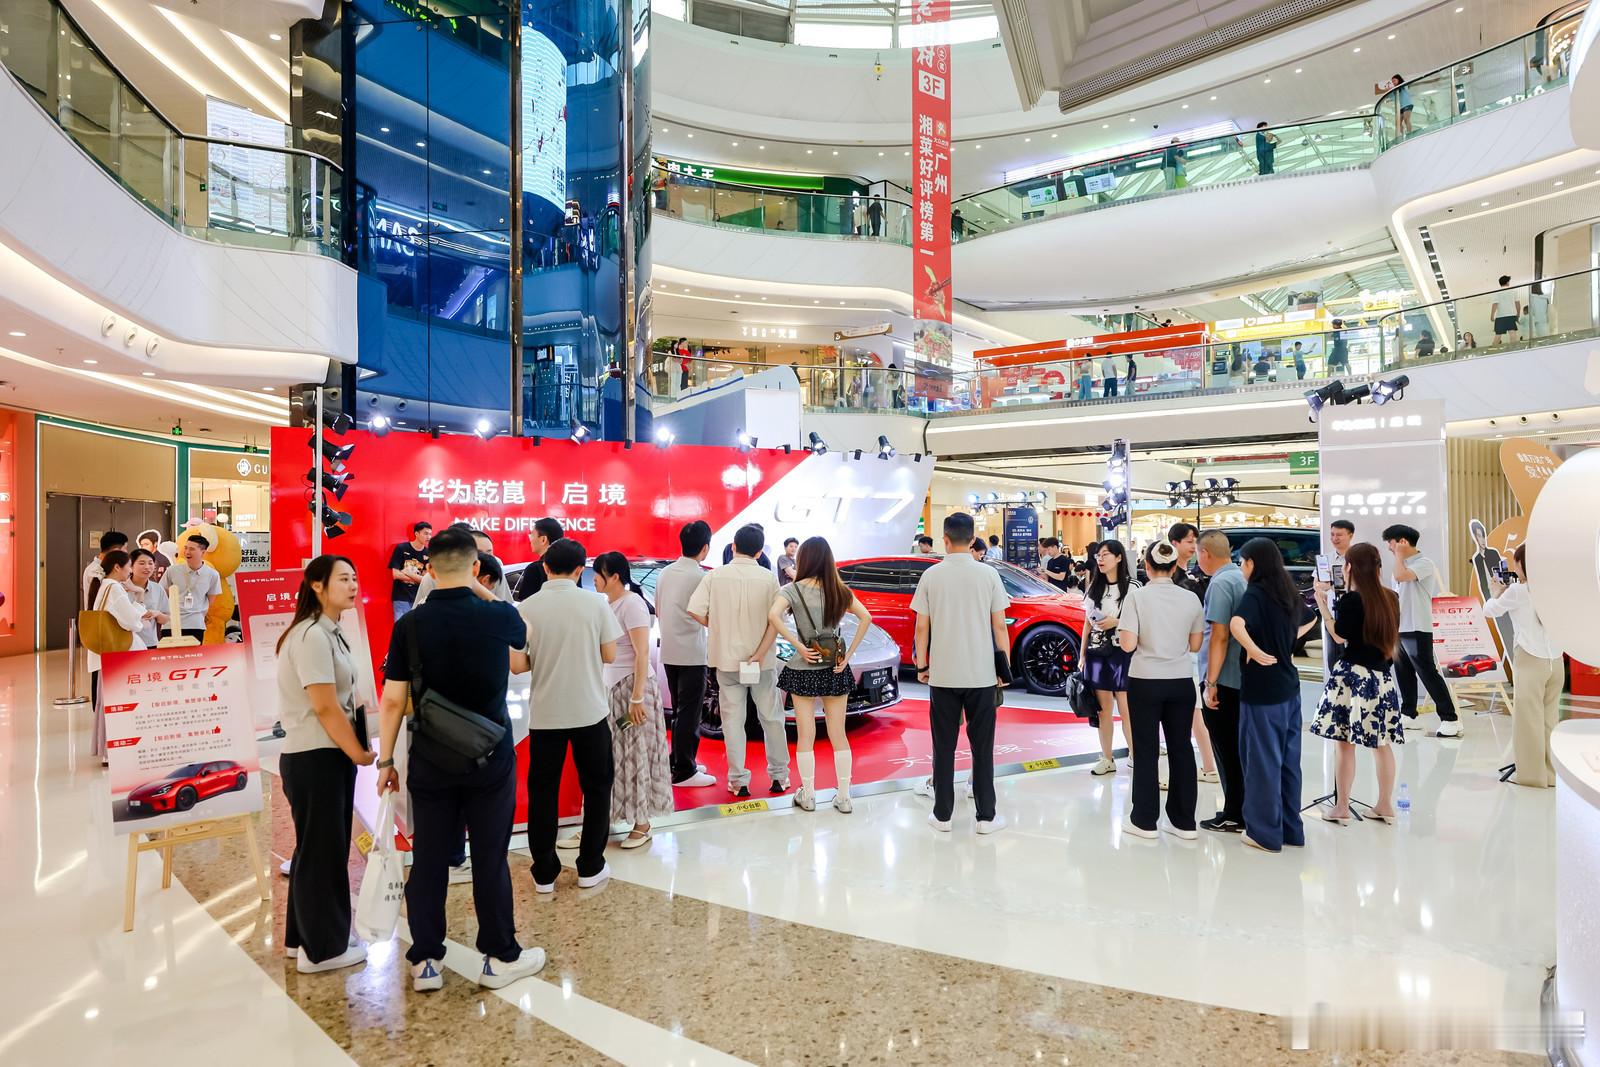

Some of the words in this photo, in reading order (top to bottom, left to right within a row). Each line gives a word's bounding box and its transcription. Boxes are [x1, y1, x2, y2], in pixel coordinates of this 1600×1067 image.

[923, 75, 941, 95] 3F
[934, 152, 948, 195] 广州
[919, 113, 934, 256] 湘菜好评榜第一
[1299, 455, 1316, 466] 3F
[418, 477, 526, 505] 华为乾崑
[561, 482, 627, 506] 启境
[774, 488, 915, 524] GT7
[504, 517, 596, 532] DIFFENCE
[127, 671, 162, 685] 启境
[168, 666, 228, 681] GT7
[872, 677, 886, 685] GT7
